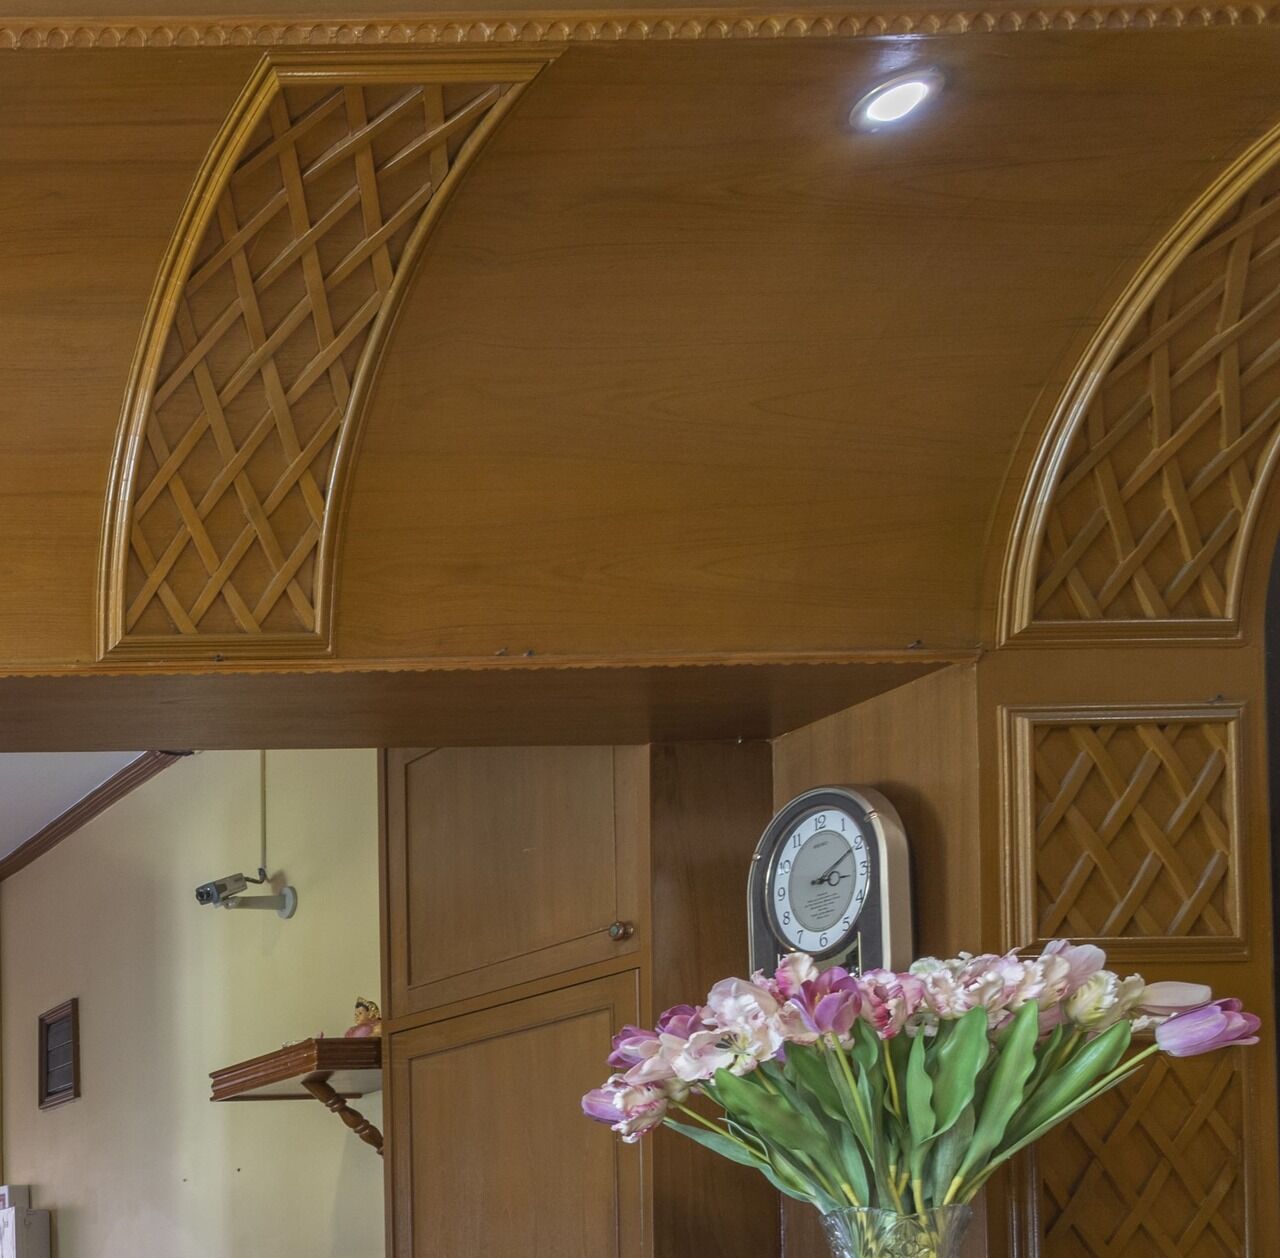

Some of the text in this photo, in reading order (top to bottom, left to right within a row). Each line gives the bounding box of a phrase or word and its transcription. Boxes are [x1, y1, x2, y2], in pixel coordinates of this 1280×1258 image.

[814, 814, 826, 831] 12
[840, 818, 846, 832] 1
[792, 833, 802, 849] 11
[854, 835, 863, 850] 2
[778, 859, 791, 876] 10
[859, 861, 868, 876] 3
[777, 887, 786, 901] 9
[855, 889, 864, 904] 4
[782, 911, 790, 926] 8
[842, 917, 851, 932] 5
[796, 929, 804, 944] 7
[819, 932, 828, 948] 6
